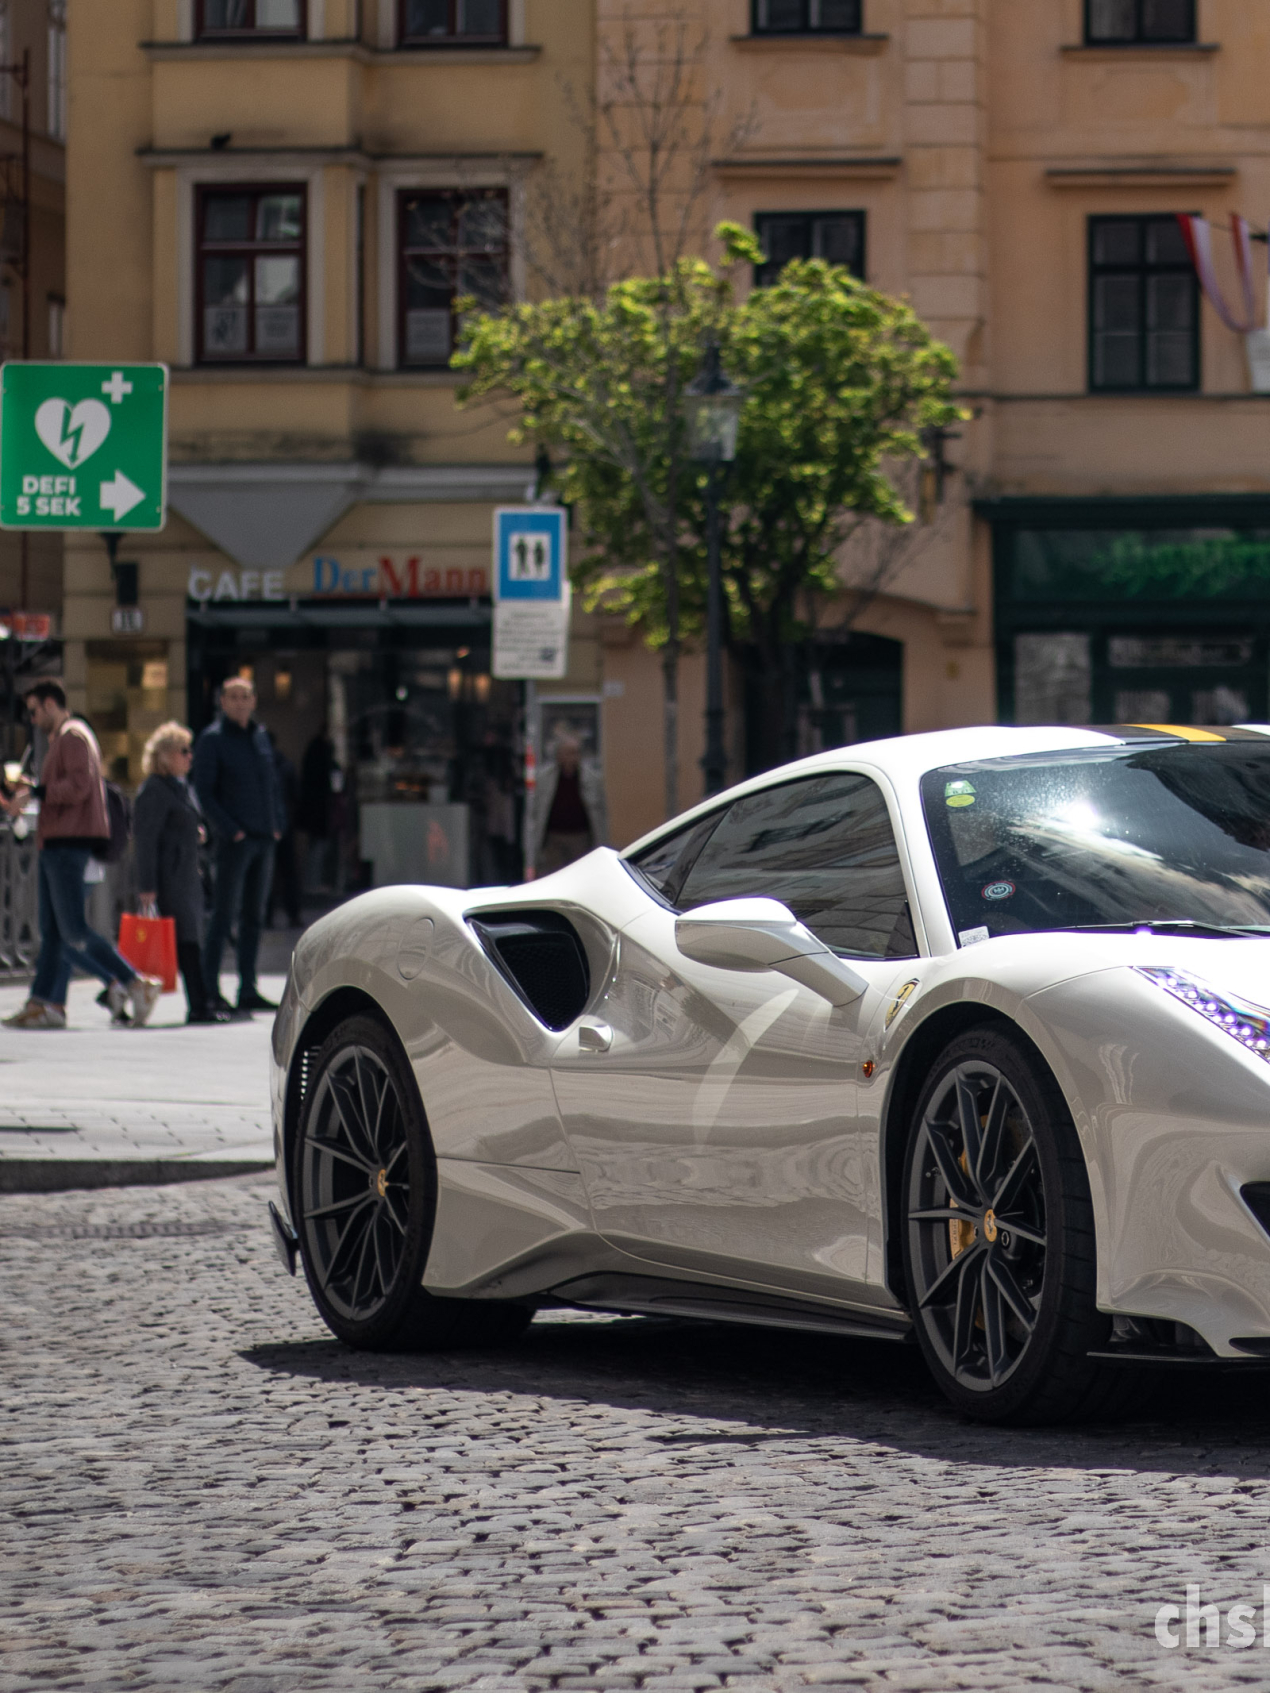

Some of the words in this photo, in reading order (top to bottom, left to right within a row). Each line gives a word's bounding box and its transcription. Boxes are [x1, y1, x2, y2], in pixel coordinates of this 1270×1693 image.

[22, 475, 76, 495] DEFI
[16, 496, 30, 516] 5
[35, 497, 81, 517] SEK
